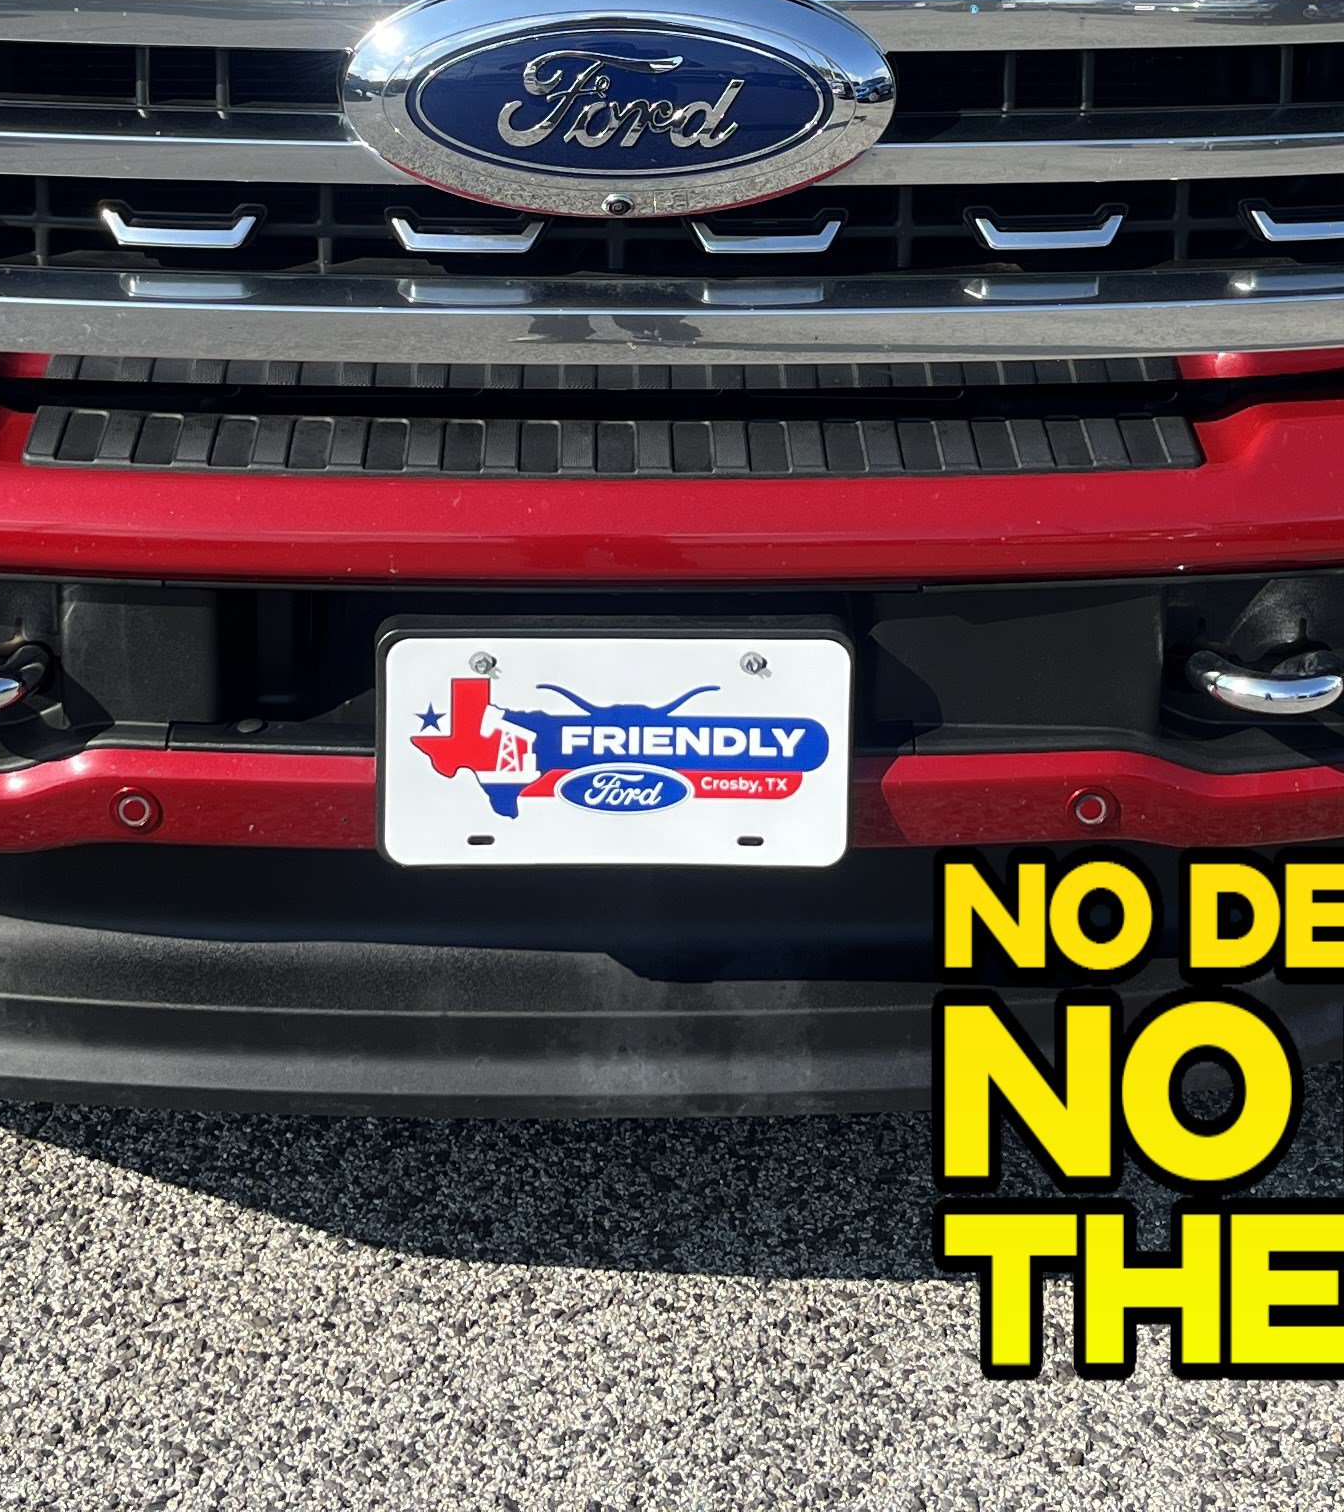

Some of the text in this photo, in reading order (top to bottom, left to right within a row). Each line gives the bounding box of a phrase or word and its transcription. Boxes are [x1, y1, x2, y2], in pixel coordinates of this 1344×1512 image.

[497, 49, 745, 149] Ford
[560, 725, 806, 758] FRIENDLY
[583, 772, 663, 807] Ford
[700, 775, 788, 793] Crosby, TX
